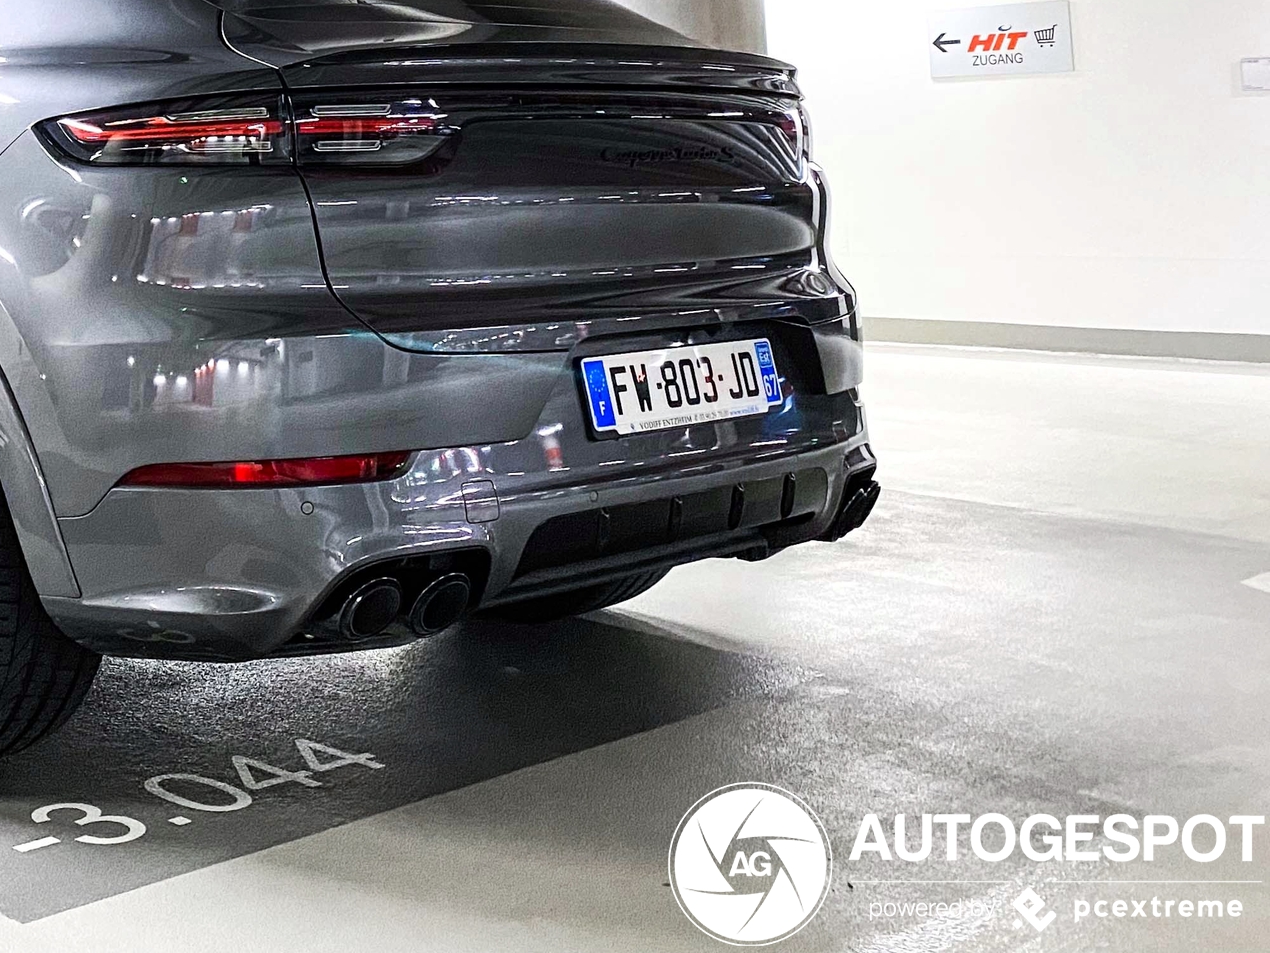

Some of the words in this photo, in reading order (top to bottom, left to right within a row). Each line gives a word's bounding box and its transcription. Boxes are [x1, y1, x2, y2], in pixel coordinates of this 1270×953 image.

[967, 25, 1029, 53] HIT
[972, 52, 1024, 67] ZUGANG
[763, 373, 778, 397] 67
[599, 401, 607, 417] F
